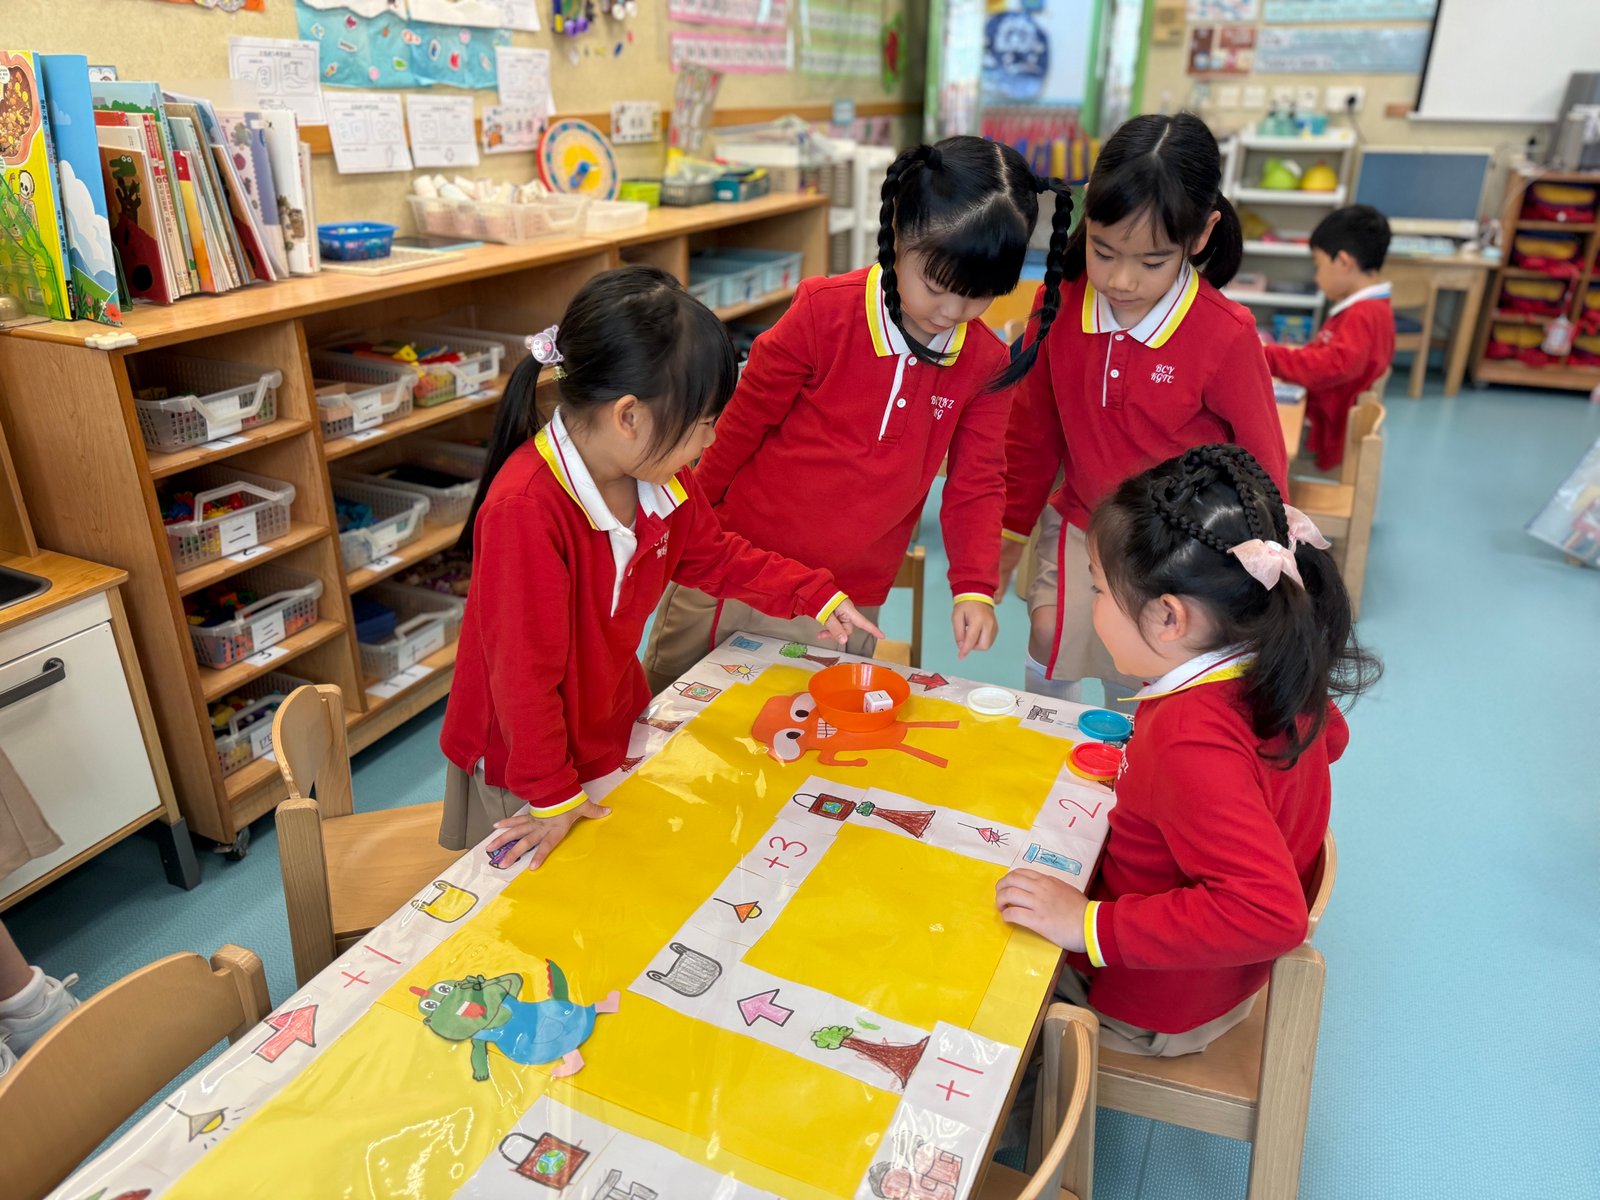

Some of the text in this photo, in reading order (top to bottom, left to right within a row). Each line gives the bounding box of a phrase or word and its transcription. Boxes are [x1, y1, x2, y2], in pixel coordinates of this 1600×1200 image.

[1058, 798, 1102, 828] -2
[763, 836, 808, 869] +3
[340, 944, 402, 988] +1
[936, 1056, 984, 1101] +1
